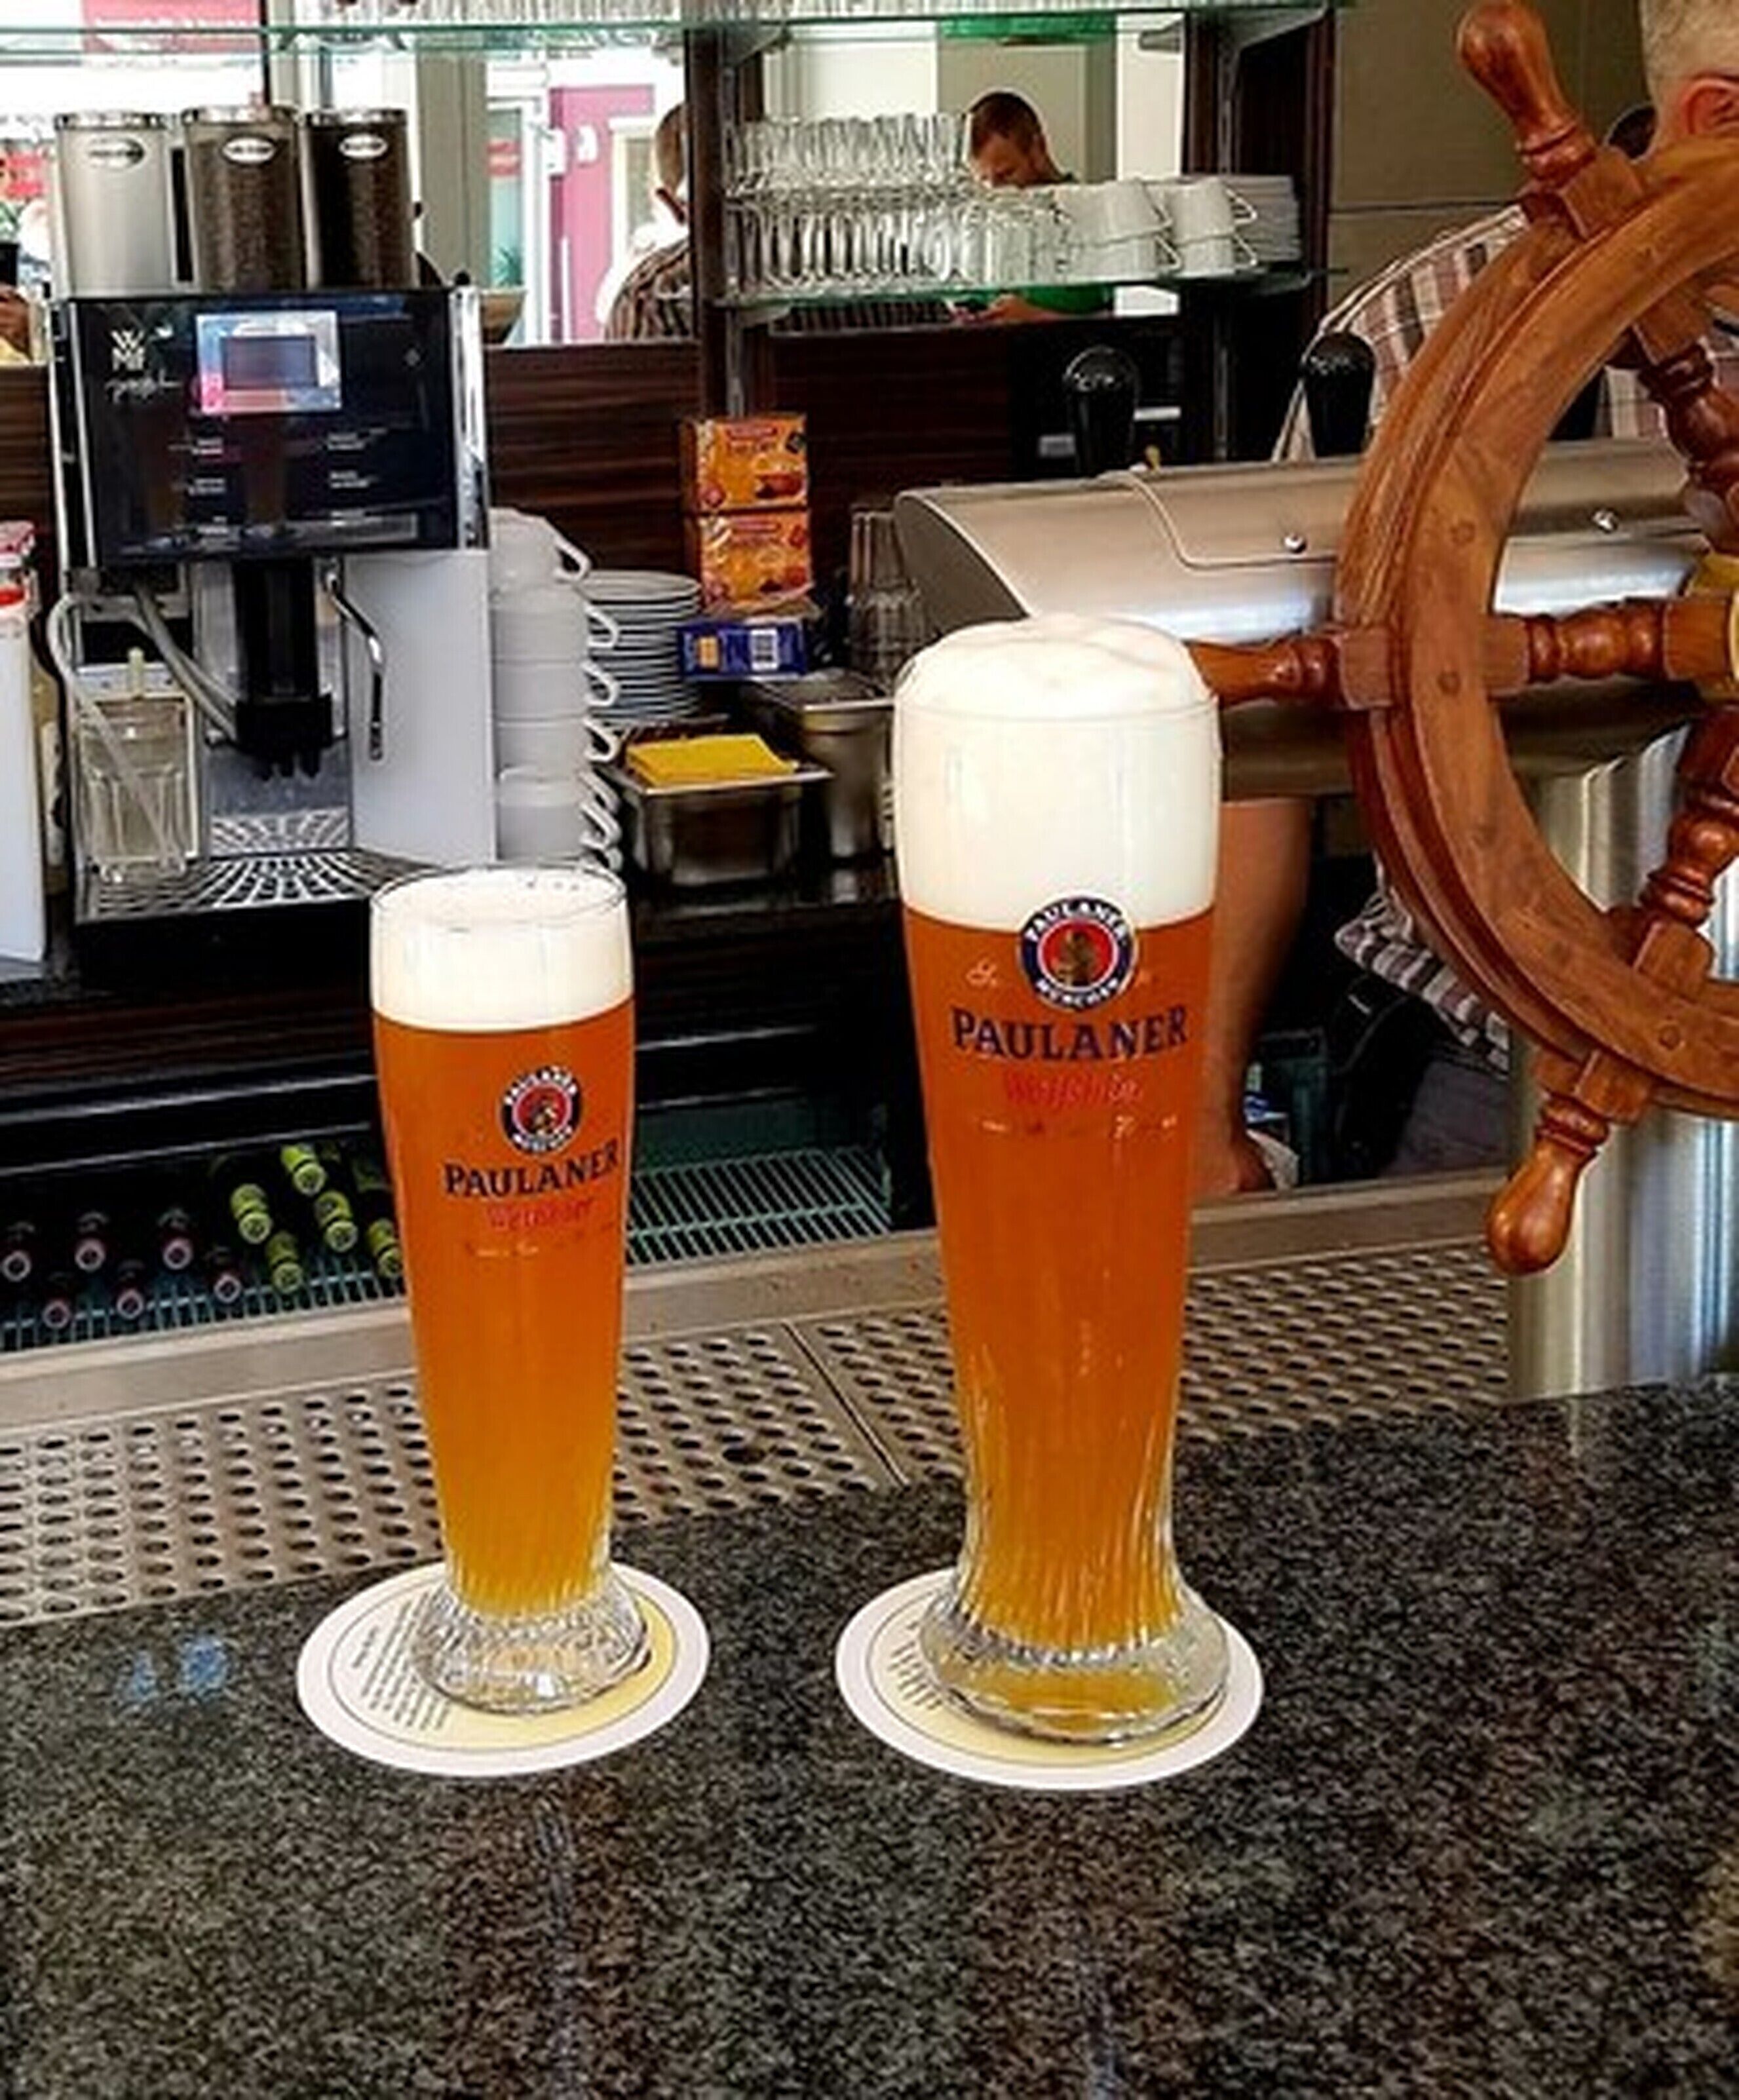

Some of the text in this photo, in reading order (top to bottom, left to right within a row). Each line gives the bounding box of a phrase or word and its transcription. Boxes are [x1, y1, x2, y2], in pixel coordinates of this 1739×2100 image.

[1023, 900, 1128, 942] PAULANER
[951, 1004, 1188, 1062] PAULANER
[442, 1137, 620, 1198] PAULANER
